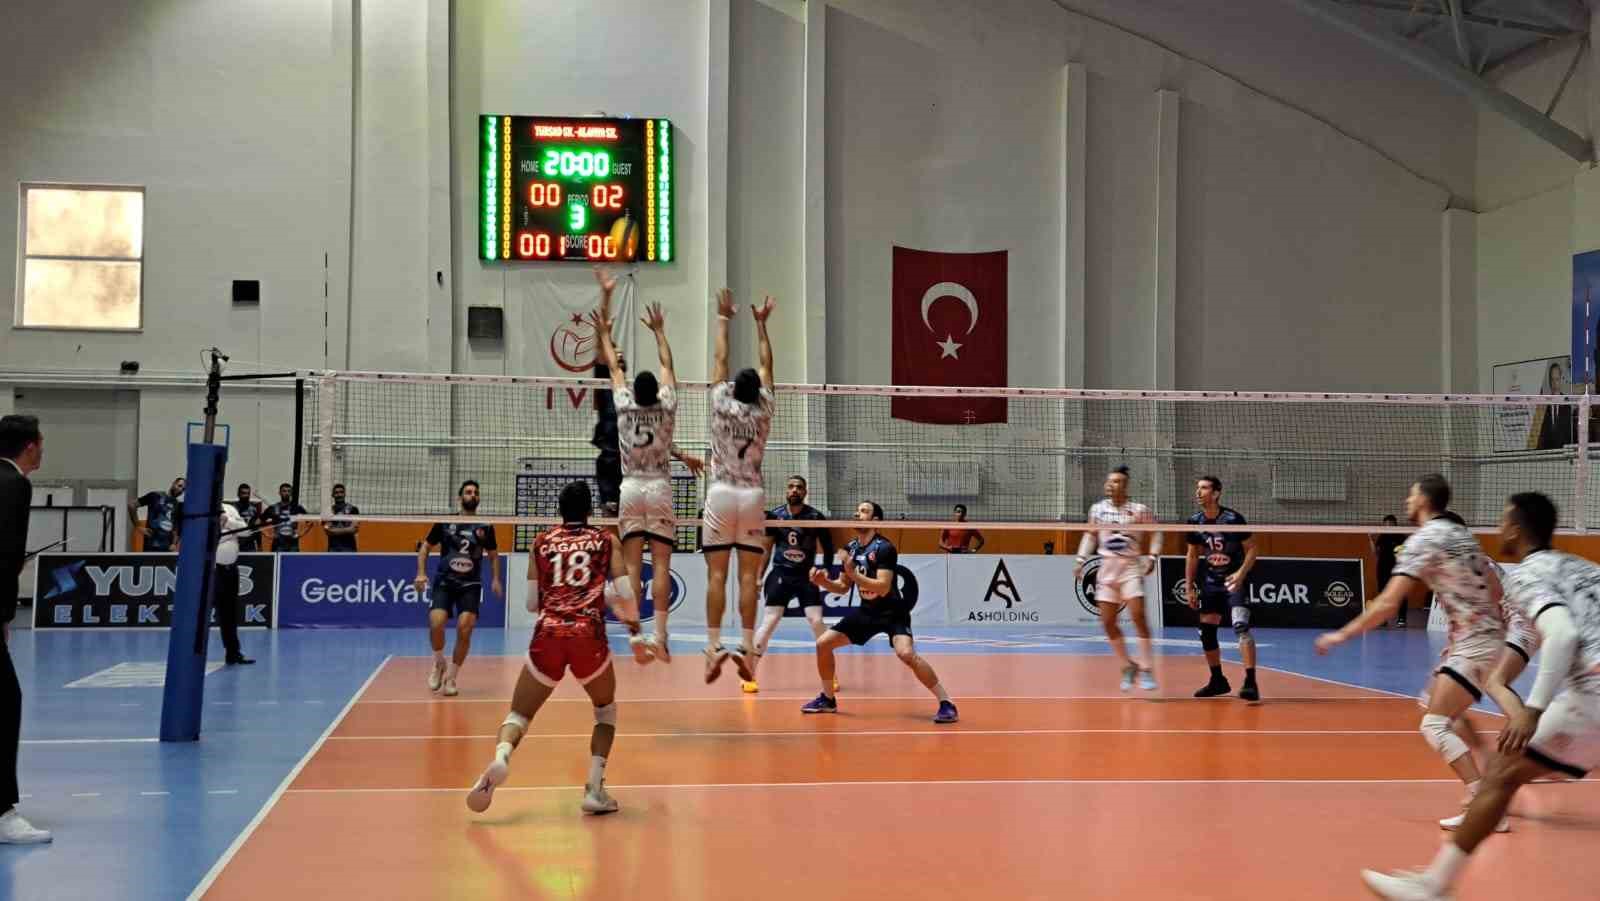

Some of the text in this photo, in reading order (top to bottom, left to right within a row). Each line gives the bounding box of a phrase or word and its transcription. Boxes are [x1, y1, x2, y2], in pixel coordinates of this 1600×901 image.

[520, 160, 539, 173] HOME
[544, 150, 610, 176] 20:00
[612, 163, 632, 176] GUEST
[530, 183, 560, 206] 00
[593, 185, 623, 208] 02
[569, 204, 585, 230] 3
[565, 234, 588, 249] SCORE
[633, 424, 655, 448] 5
[734, 435, 757, 459] 7
[460, 539, 470, 554] 2
[788, 531, 798, 545] 6
[1206, 535, 1224, 551] 15
[550, 550, 593, 588] 18
[84, 565, 254, 597] YUNS
[54, 604, 267, 623] ELEKK
[968, 610, 1040, 622] ASHOLDING
